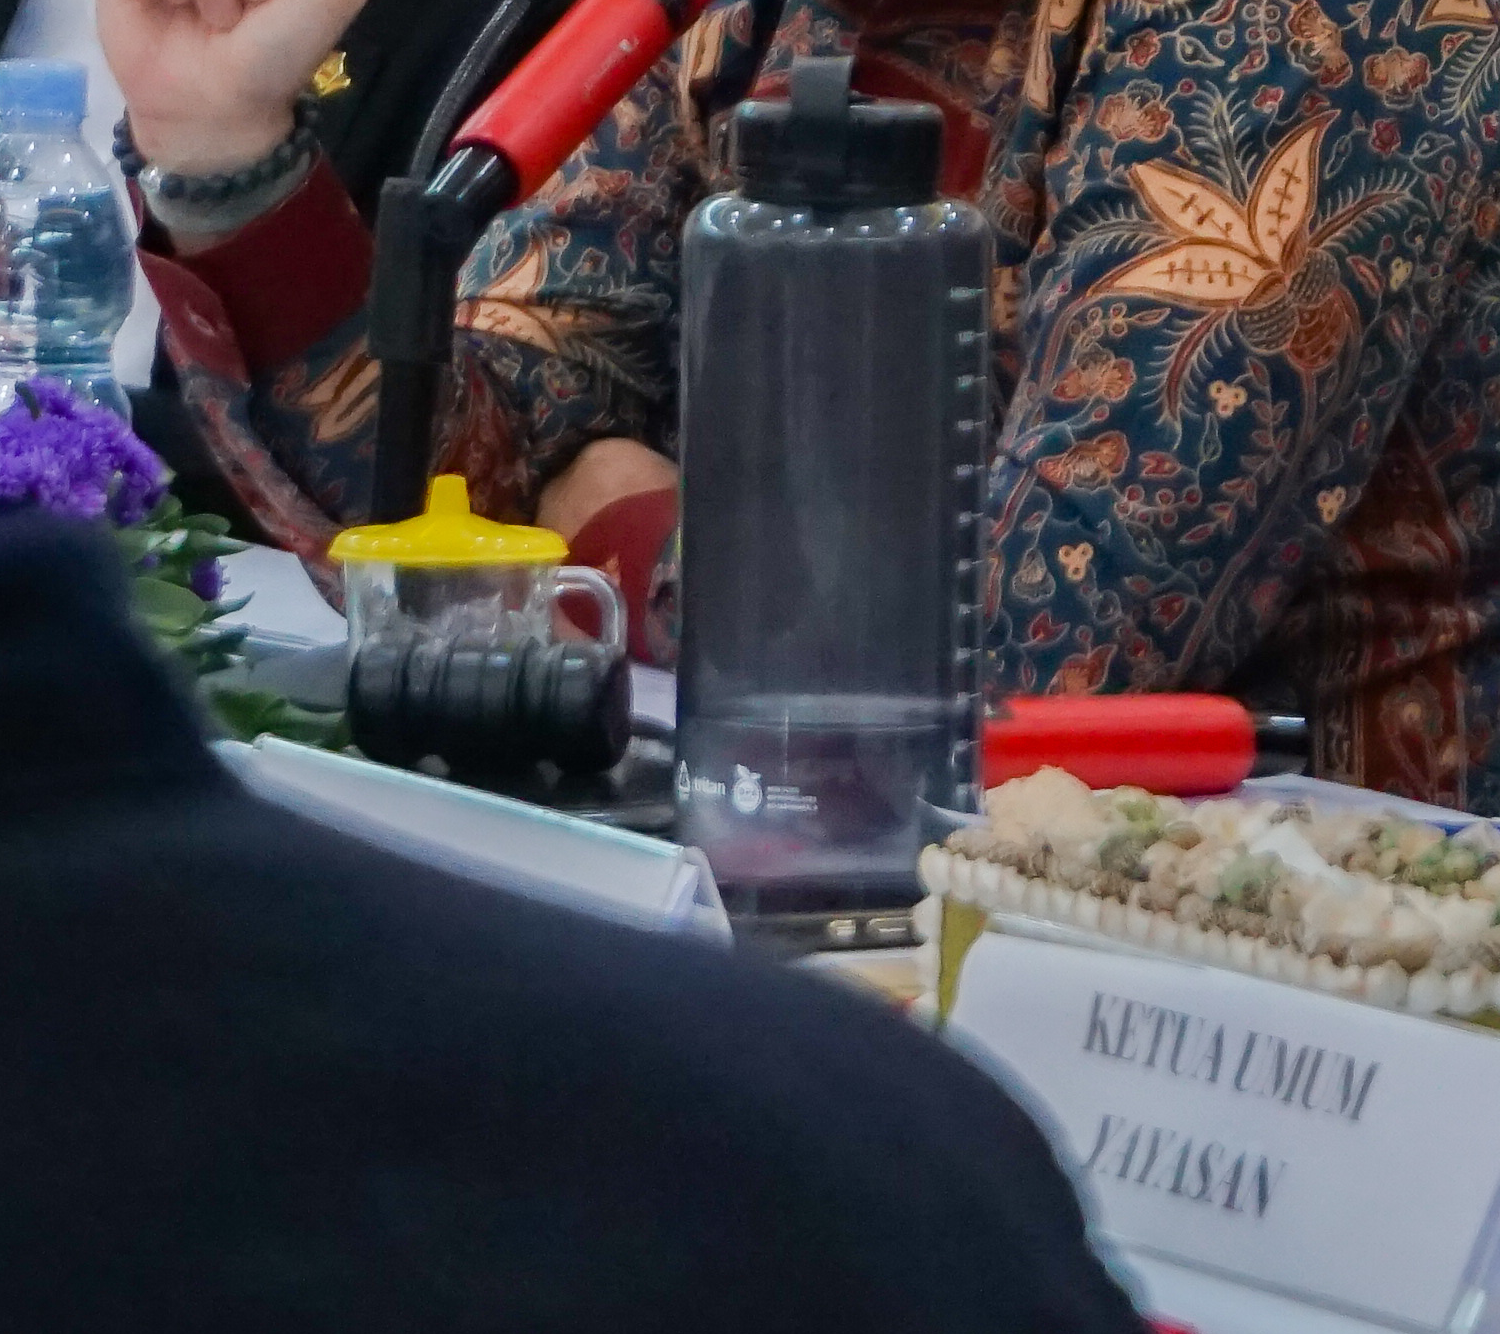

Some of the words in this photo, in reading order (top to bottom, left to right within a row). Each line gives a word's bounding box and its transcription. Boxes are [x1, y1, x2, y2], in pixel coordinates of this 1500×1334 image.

[1082, 990, 1225, 1085] KETUA
[1232, 1028, 1382, 1121] UMUM
[1078, 1114, 1289, 1218] YAYASAN
